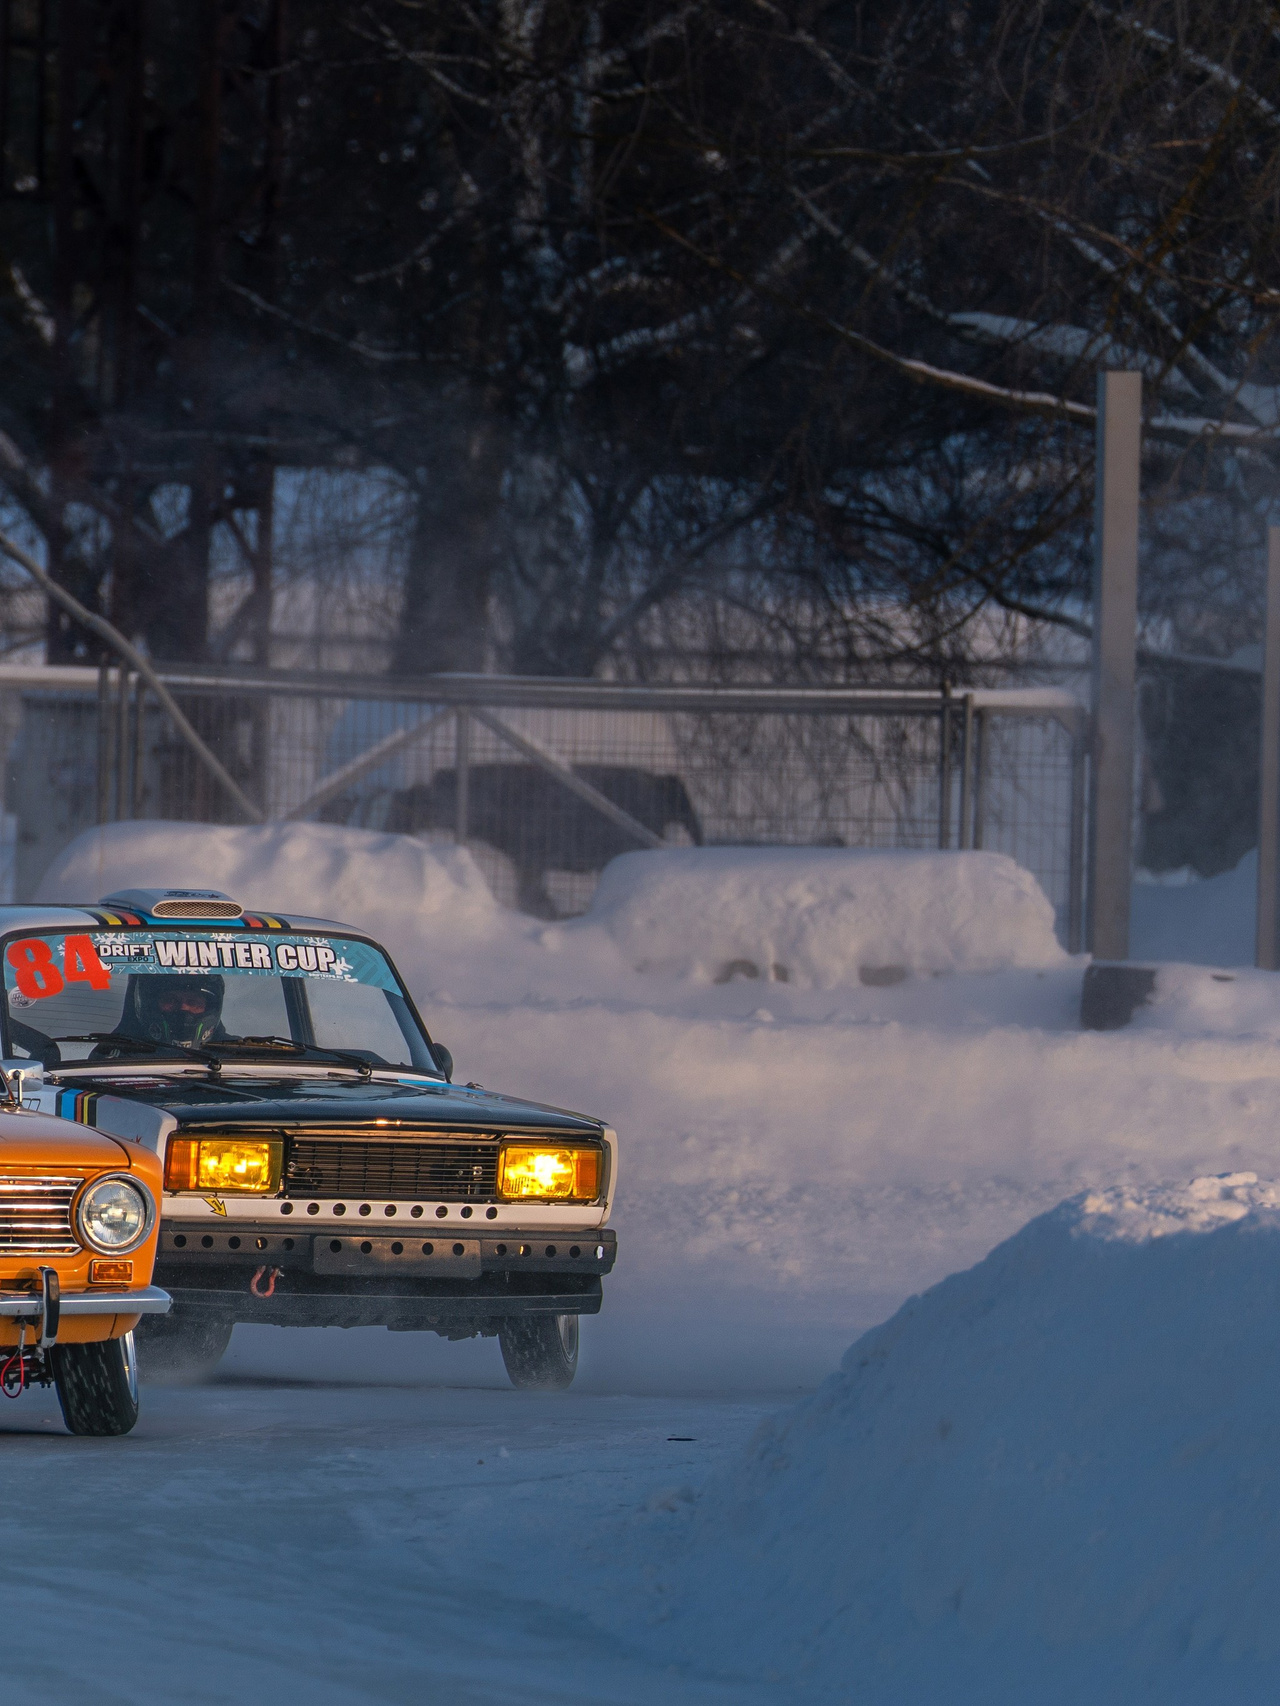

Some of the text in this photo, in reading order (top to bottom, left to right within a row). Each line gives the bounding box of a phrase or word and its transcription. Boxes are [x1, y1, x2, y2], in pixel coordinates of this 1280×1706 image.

[6, 934, 112, 999] 84
[99, 944, 152, 957] DRIFT
[154, 940, 336, 973] WINTER CUP
